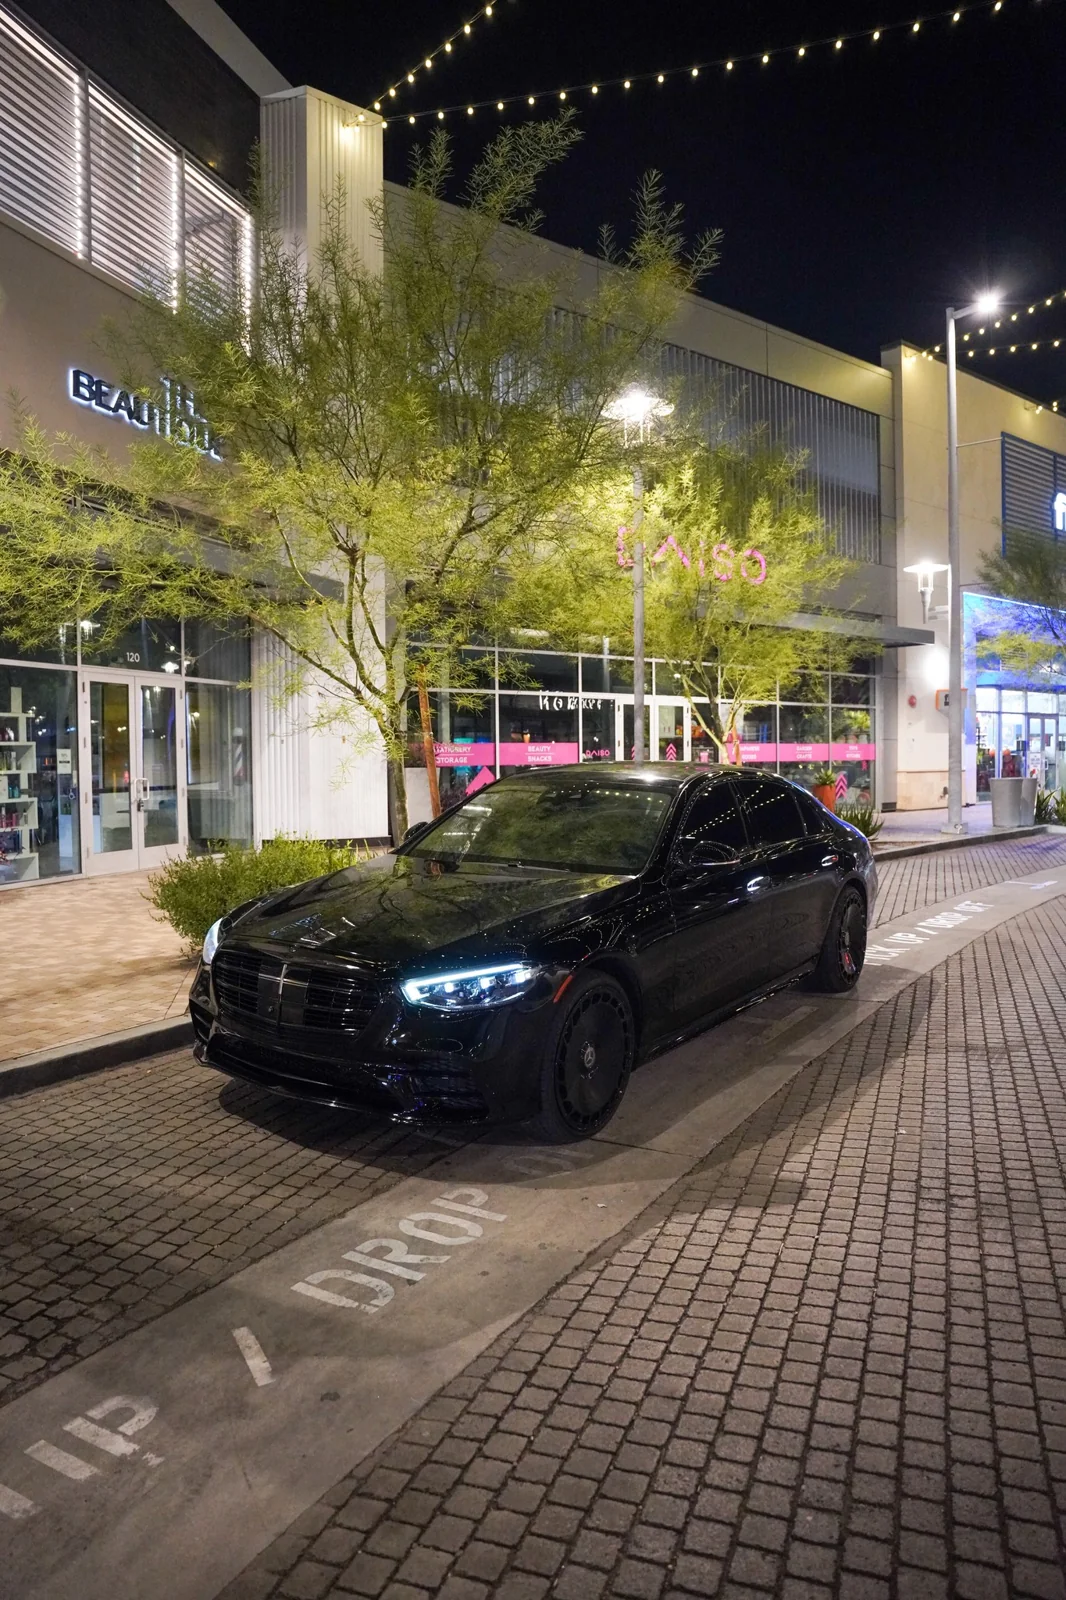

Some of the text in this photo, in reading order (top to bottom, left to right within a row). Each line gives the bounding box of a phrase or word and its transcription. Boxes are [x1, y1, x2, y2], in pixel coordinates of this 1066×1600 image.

[126, 651, 140, 663] 120
[527, 745, 551, 753] BEAUTY
[585, 749, 610, 757] DAISO
[527, 755, 552, 763] SNACKS
[290, 1186, 508, 1314] DROP
